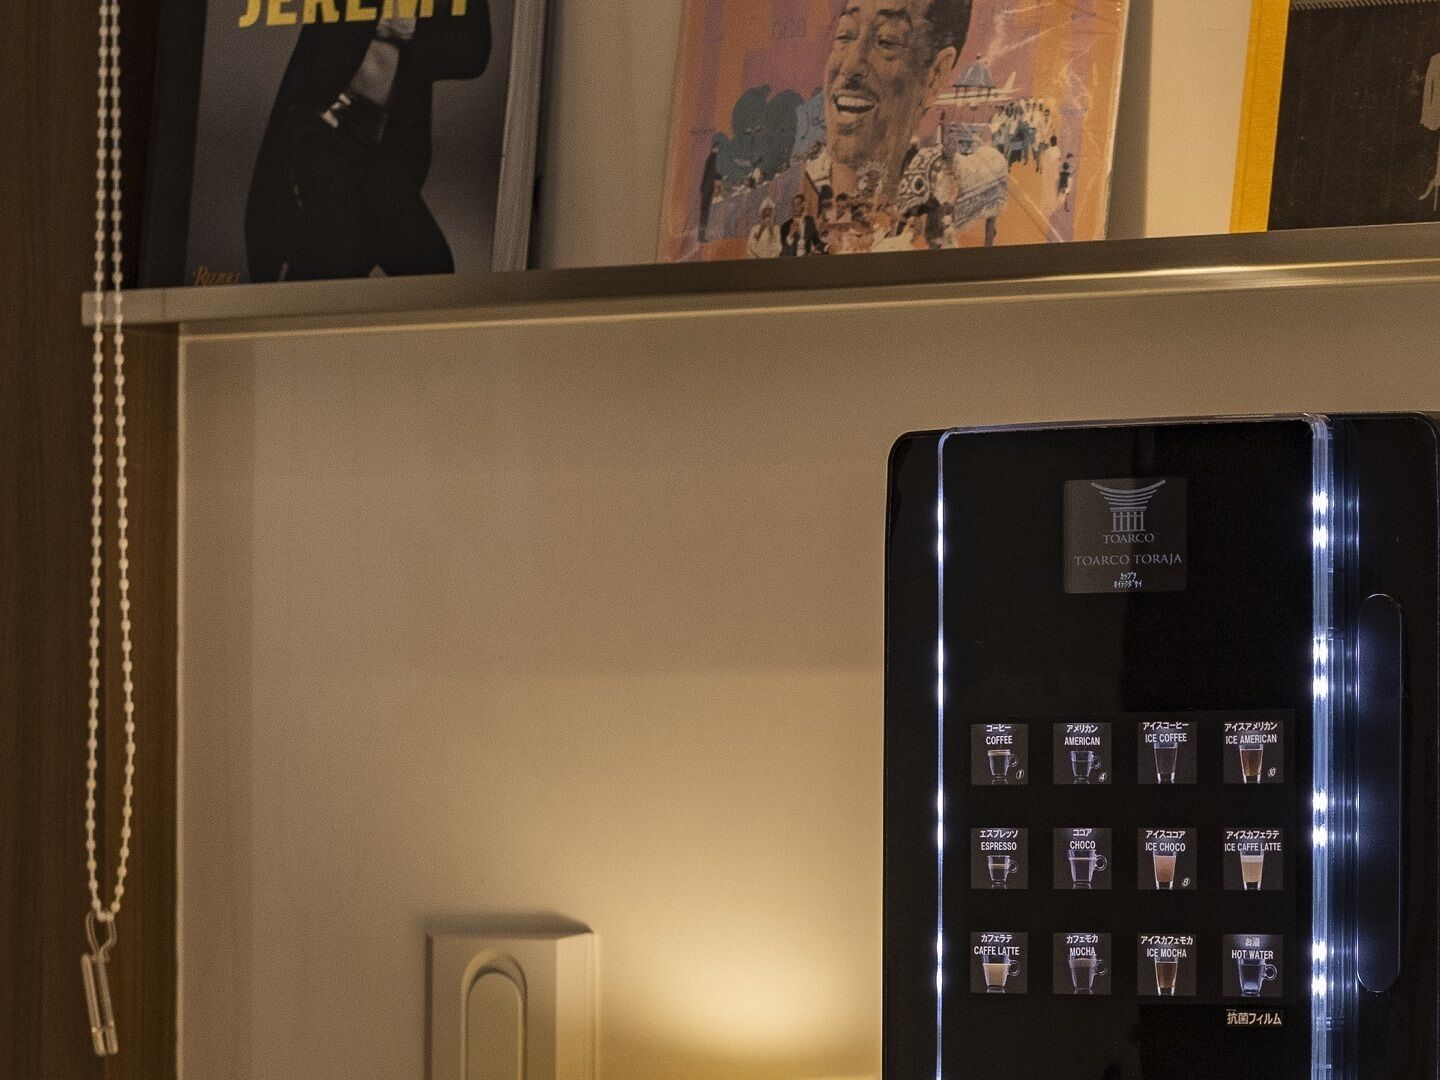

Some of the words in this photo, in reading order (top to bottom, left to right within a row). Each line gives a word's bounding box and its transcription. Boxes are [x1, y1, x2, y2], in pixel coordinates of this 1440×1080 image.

[1103, 533, 1154, 544] TOARCO
[1074, 555, 1129, 566] TOARCO
[1134, 554, 1182, 566] TORAJA
[986, 724, 1011, 732] コーヒー
[1066, 724, 1098, 733] アメリカン
[1143, 722, 1189, 731] アイスコーヒー
[1224, 722, 1278, 732] アイスアメリカン
[986, 734, 1013, 745] COFFEE
[1065, 736, 1100, 746] AMERICAN
[1145, 734, 1157, 743] ICE
[1160, 733, 1187, 743] COFFEE
[1226, 736, 1238, 744] ICE
[1240, 734, 1277, 744] AMERICAN
[980, 830, 1018, 838] エスプレッソ
[1073, 829, 1092, 837] ココア
[1146, 830, 1186, 839] アイスココア
[1226, 830, 1279, 839] アイスカフェラテ
[981, 842, 1017, 850] ESPRESSO
[1070, 840, 1096, 849] CHOCO
[1146, 842, 1157, 852] ICE
[1159, 842, 1186, 852] CHOCO
[1225, 843, 1235, 851] ICE
[1238, 843, 1259, 851] CAFFE
[1261, 843, 1282, 851] LATTE
[981, 934, 1012, 943] カフェラテ
[1066, 934, 1099, 944] カフェモカ
[1141, 936, 1194, 946] アイスカフェモカ
[1245, 937, 1260, 947] お湯
[974, 946, 996, 955] CAFFE
[998, 947, 1020, 955] LATTE
[1070, 947, 1096, 956] MOCHA
[1147, 948, 1158, 958] ICE
[1160, 948, 1187, 958] MOCHA
[1232, 950, 1249, 959] HOT
[1250, 950, 1274, 960] WATER
[1227, 1012, 1282, 1025] 抗菌フィルム
